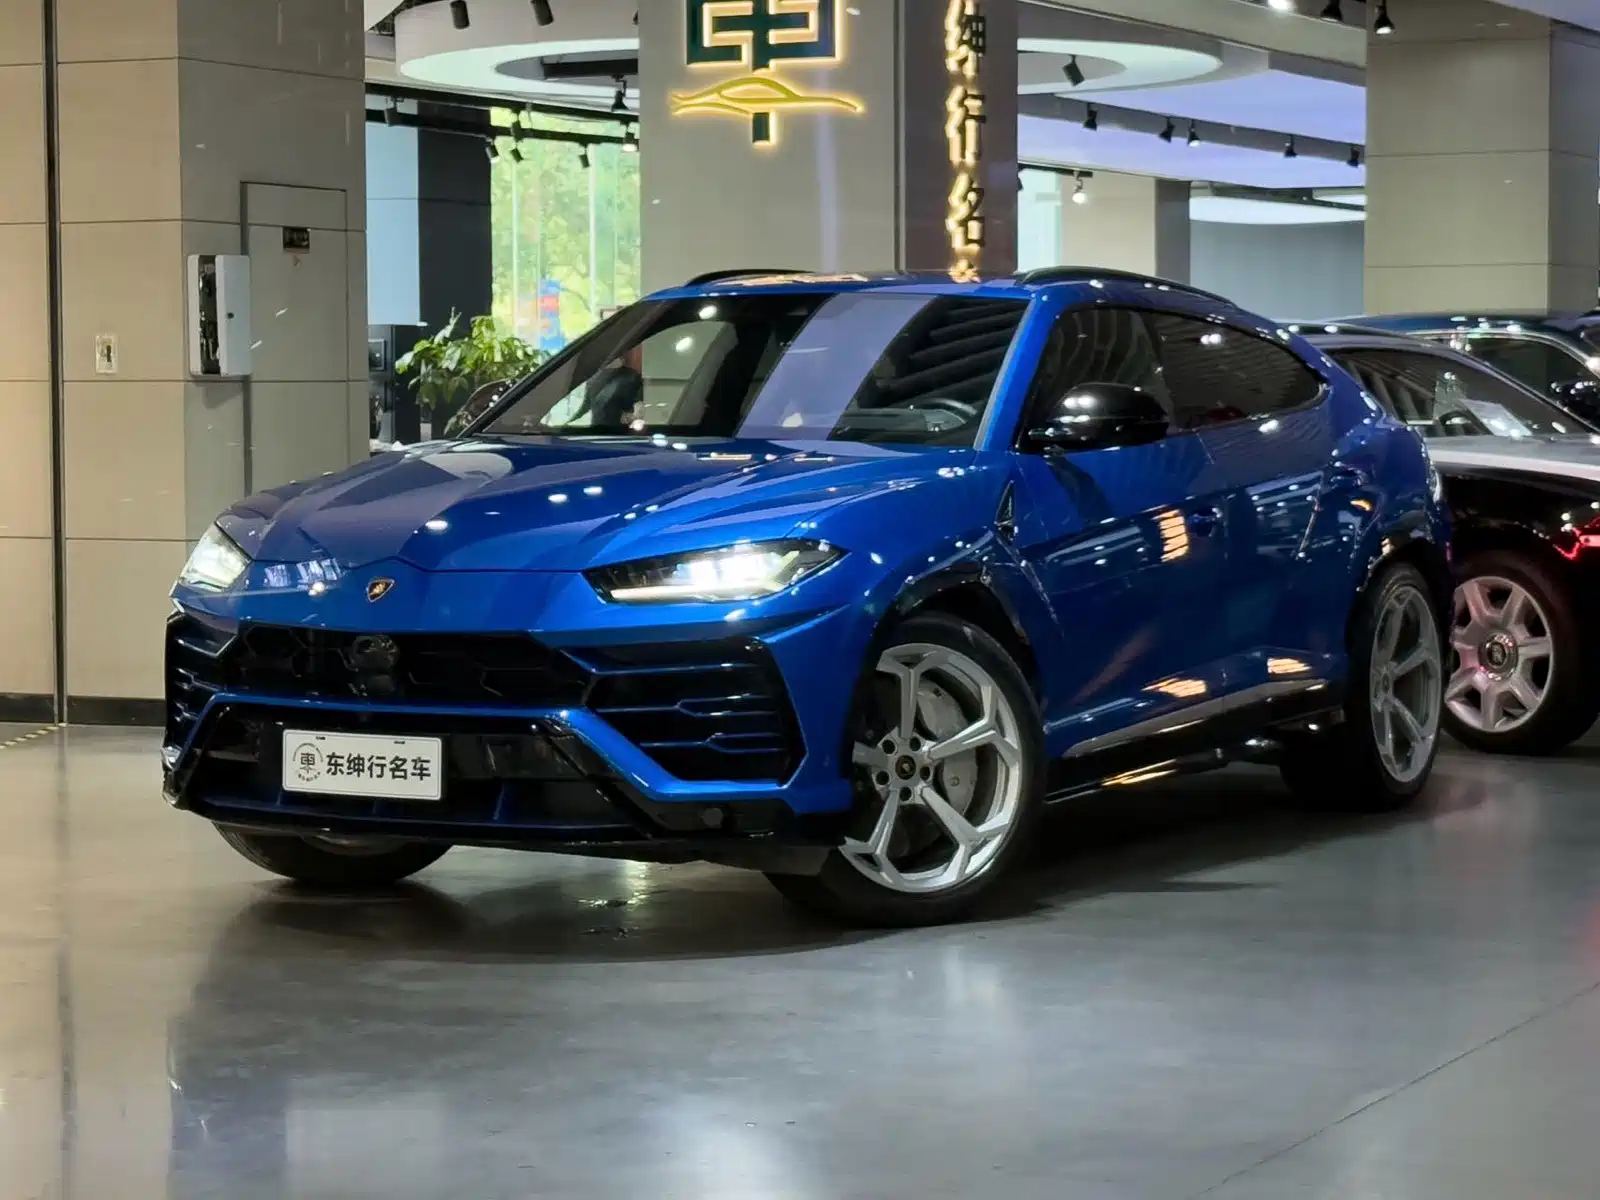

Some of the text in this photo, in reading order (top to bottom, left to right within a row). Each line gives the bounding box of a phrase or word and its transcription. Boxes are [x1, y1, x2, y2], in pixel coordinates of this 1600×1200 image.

[325, 751, 431, 781] 东绅行名车
